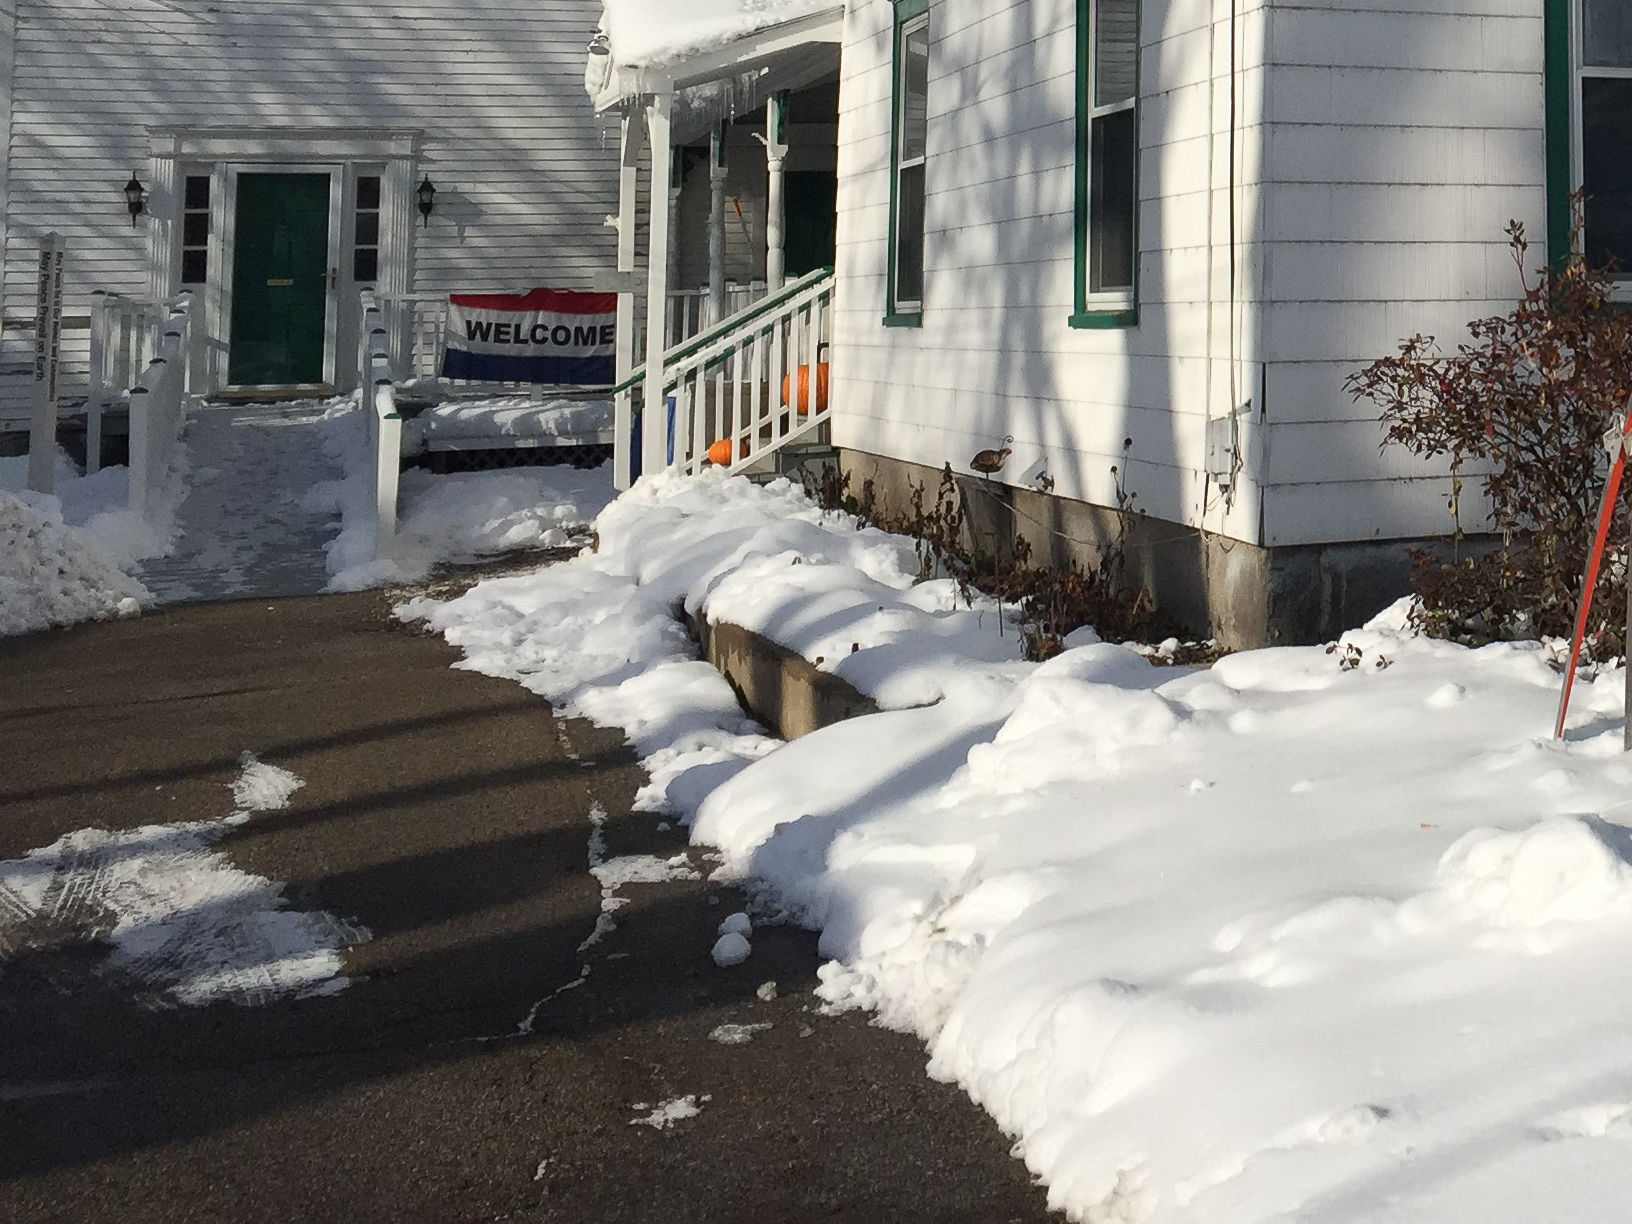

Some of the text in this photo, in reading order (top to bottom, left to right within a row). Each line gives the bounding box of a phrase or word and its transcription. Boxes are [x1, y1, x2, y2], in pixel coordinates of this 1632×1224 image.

[36, 251, 51, 382] May Peace Prevail on Earth
[465, 319, 615, 347] WELCOME
